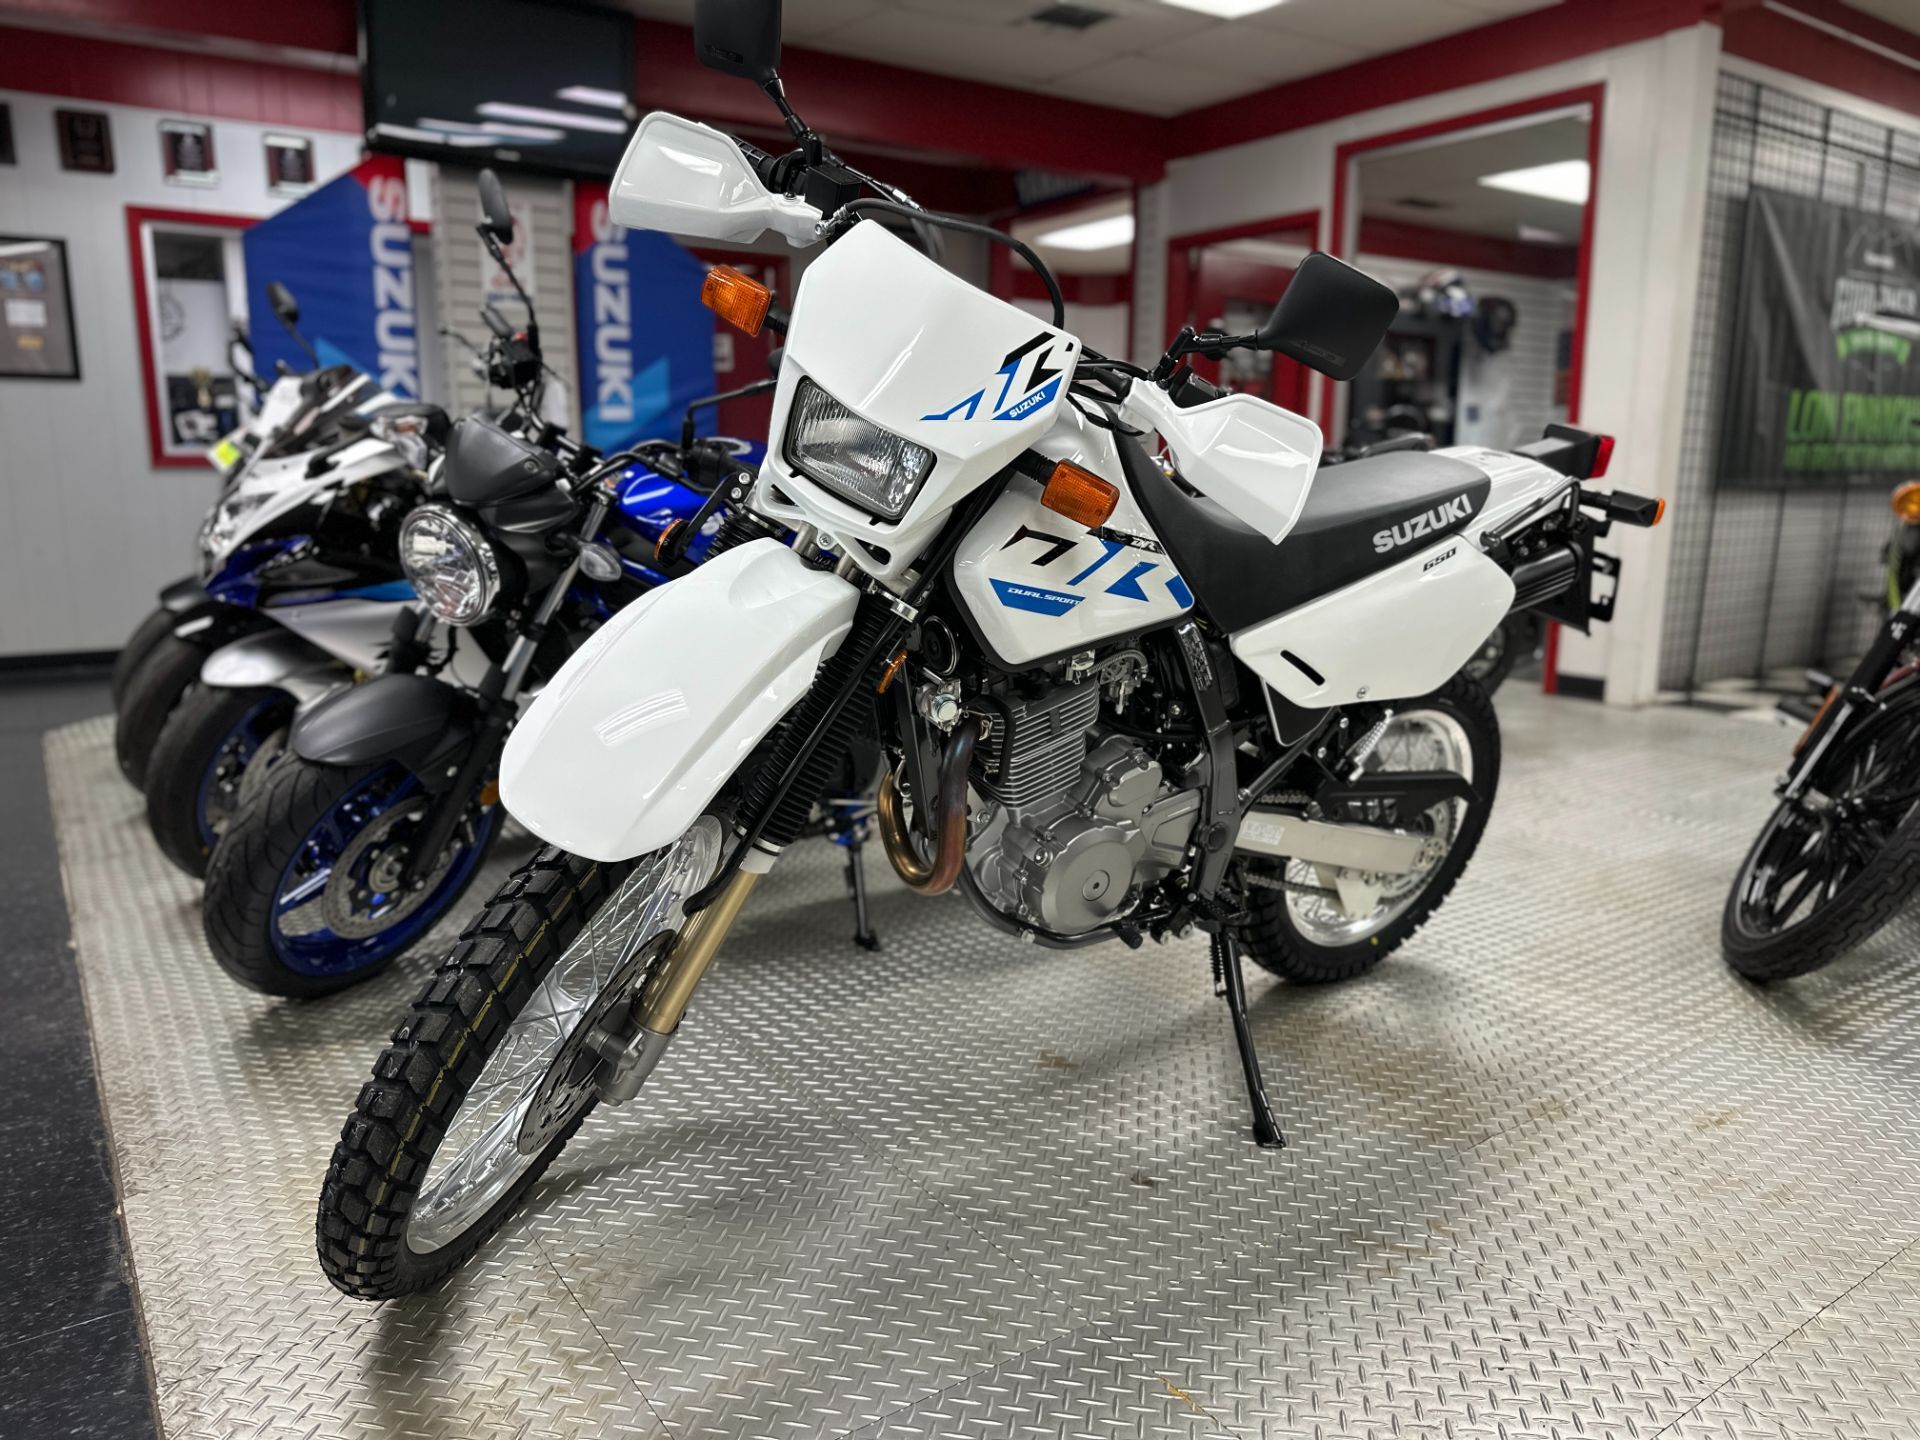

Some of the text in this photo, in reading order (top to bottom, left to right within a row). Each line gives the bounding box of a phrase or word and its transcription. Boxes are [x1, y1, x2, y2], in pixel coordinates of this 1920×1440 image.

[368, 175, 419, 404] SUZUK
[591, 199, 633, 421] SUZUKI
[1009, 391, 1046, 418] SUZUKI
[1372, 493, 1473, 553] SUZUKI
[1422, 547, 1457, 572] 650
[1007, 587, 1081, 606] DUAL SPORT
